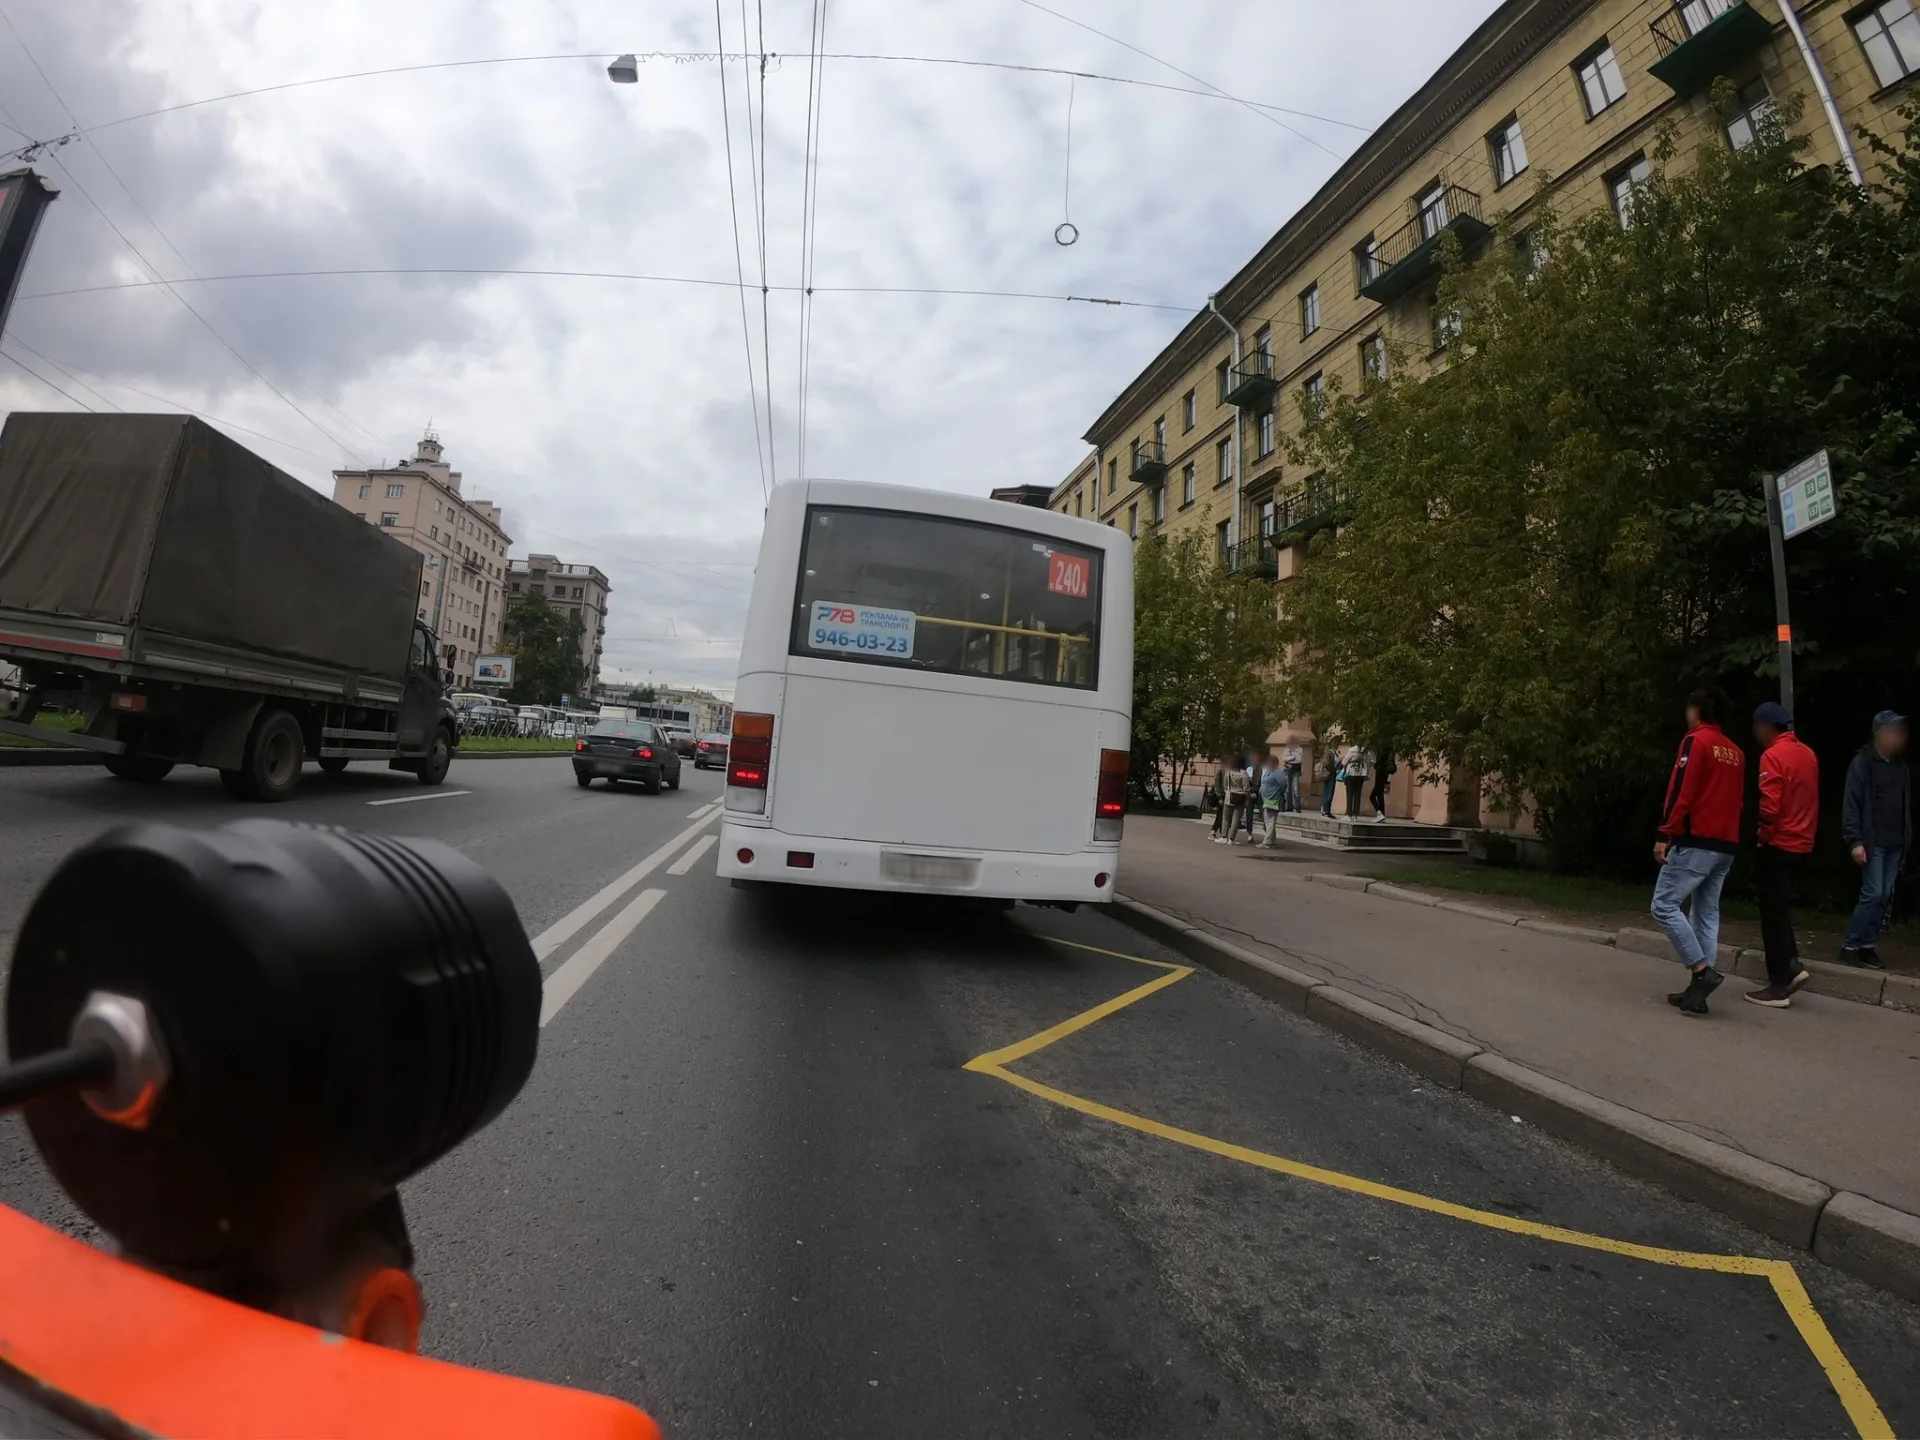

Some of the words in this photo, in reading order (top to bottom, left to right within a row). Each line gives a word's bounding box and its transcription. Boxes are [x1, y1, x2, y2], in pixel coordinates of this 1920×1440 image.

[860, 610, 898, 621] РЕКЛАМА
[860, 619, 909, 631] ТРАНСПОРТЕ
[815, 629, 908, 653] 946-03-23
